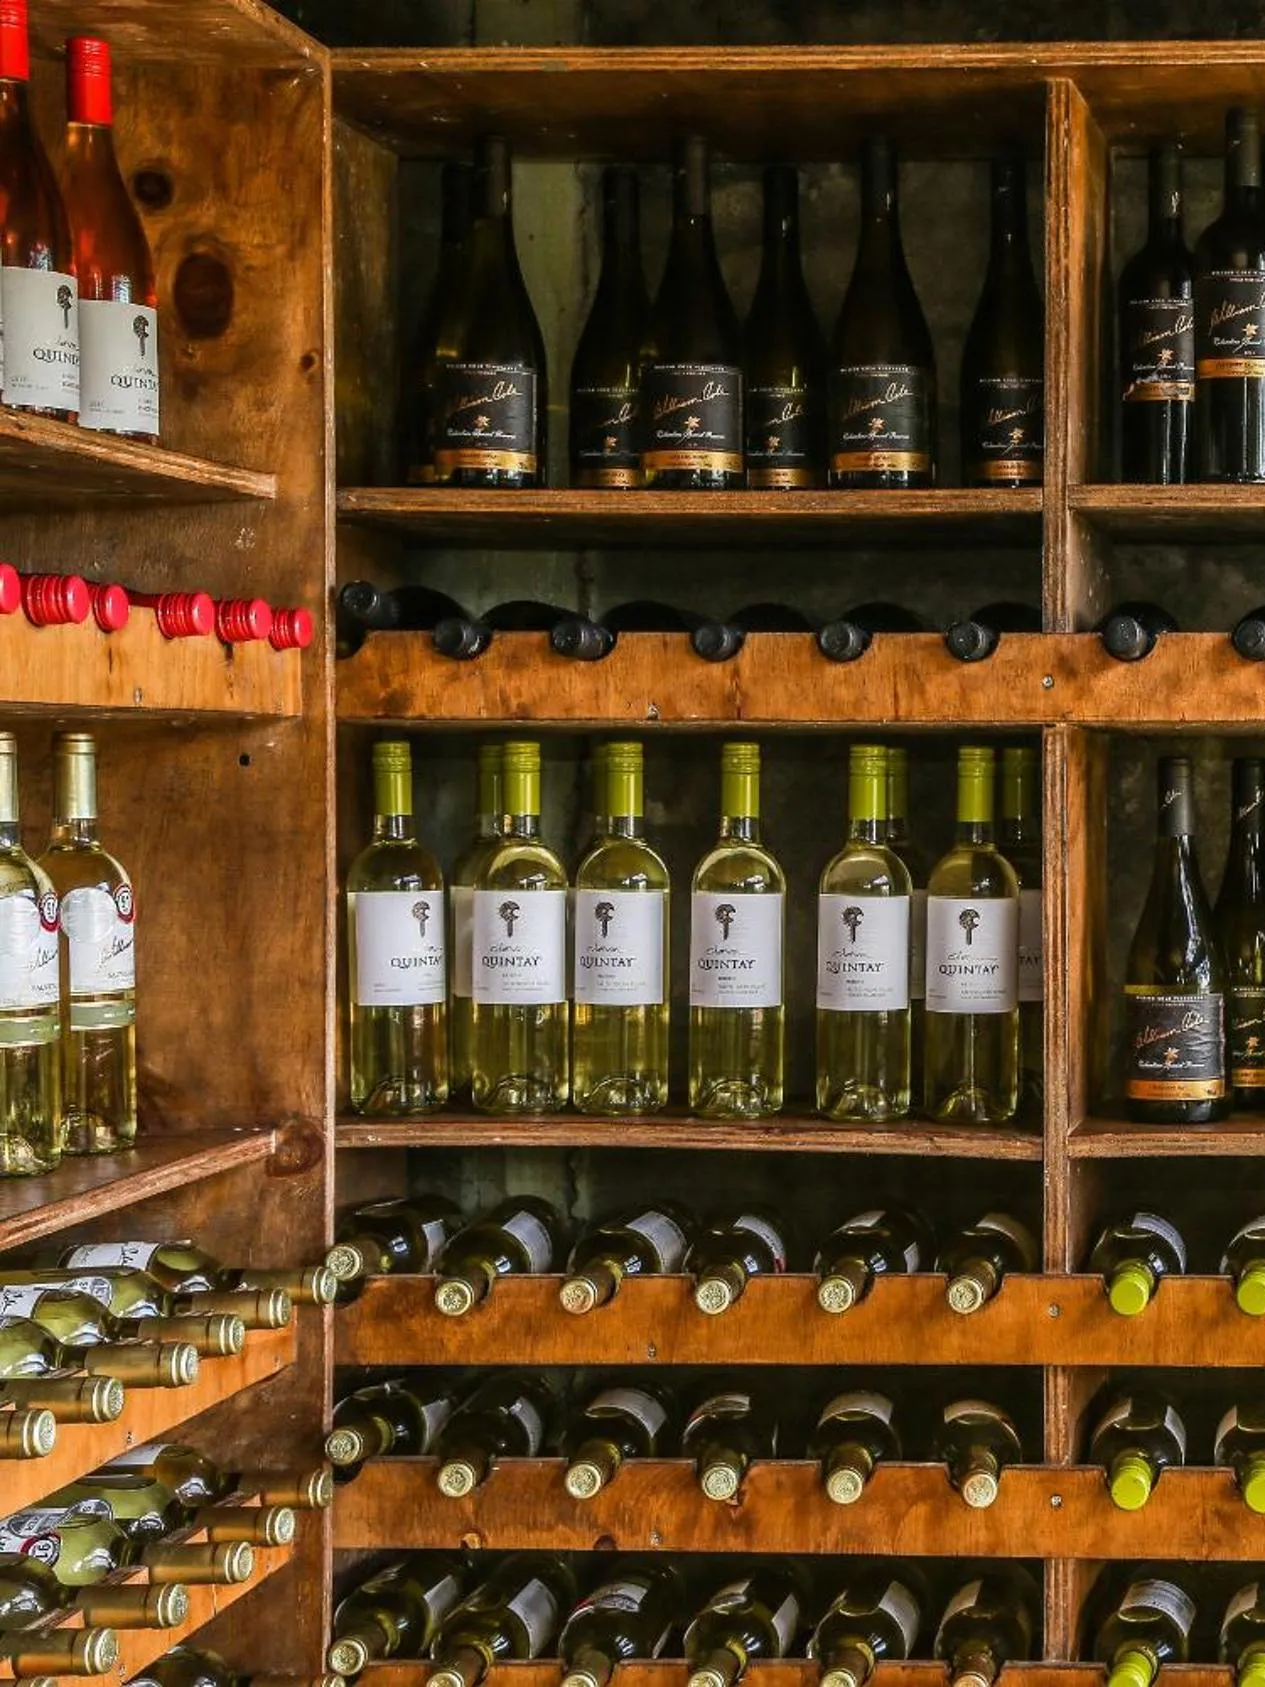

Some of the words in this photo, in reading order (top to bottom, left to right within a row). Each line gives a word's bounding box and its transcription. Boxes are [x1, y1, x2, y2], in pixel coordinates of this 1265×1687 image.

[481, 955, 540, 969] QUINTAY
[580, 956, 635, 969] QUINTAY
[697, 959, 755, 971] QUINTAY
[826, 961, 884, 974] QUINTAY
[939, 964, 999, 977] QUINTAY
